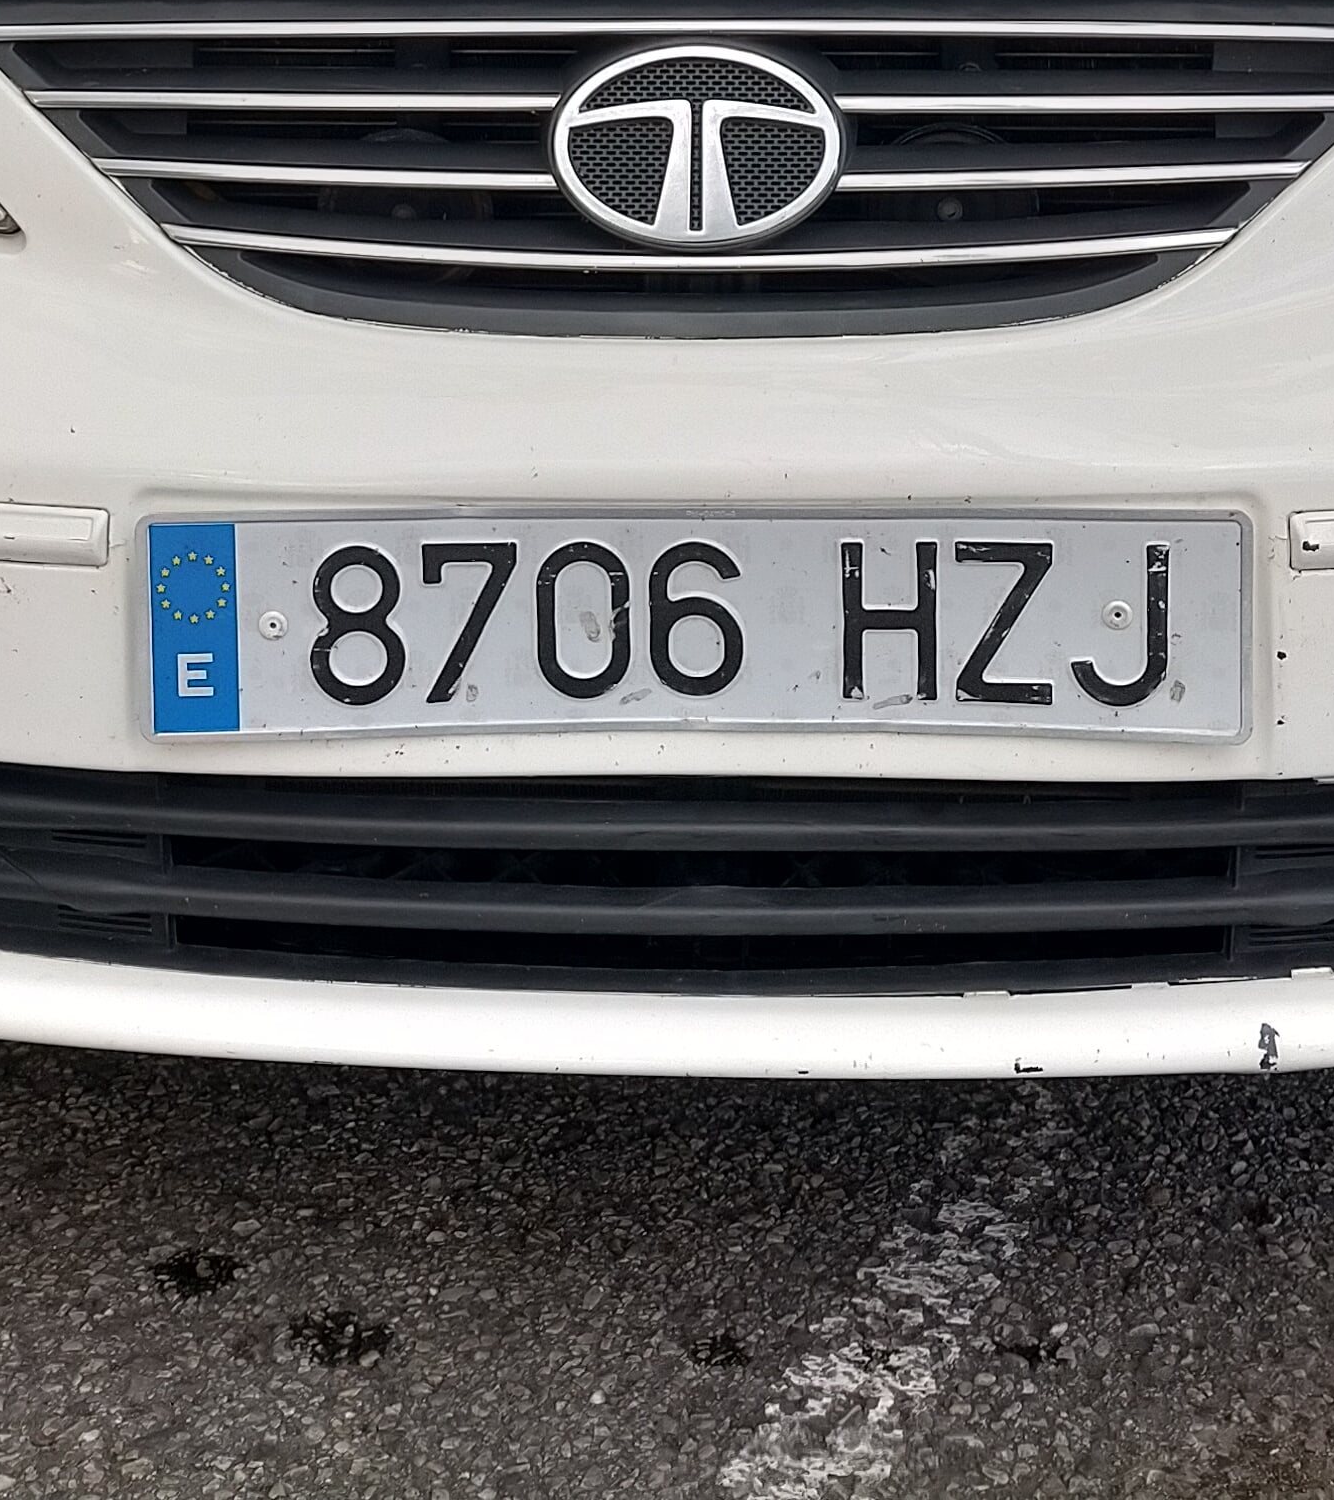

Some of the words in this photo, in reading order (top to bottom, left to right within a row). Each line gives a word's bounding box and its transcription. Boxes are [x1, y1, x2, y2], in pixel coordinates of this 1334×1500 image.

[177, 652, 215, 698] E
[309, 541, 745, 707] 8706
[840, 540, 1171, 708] HZJ
